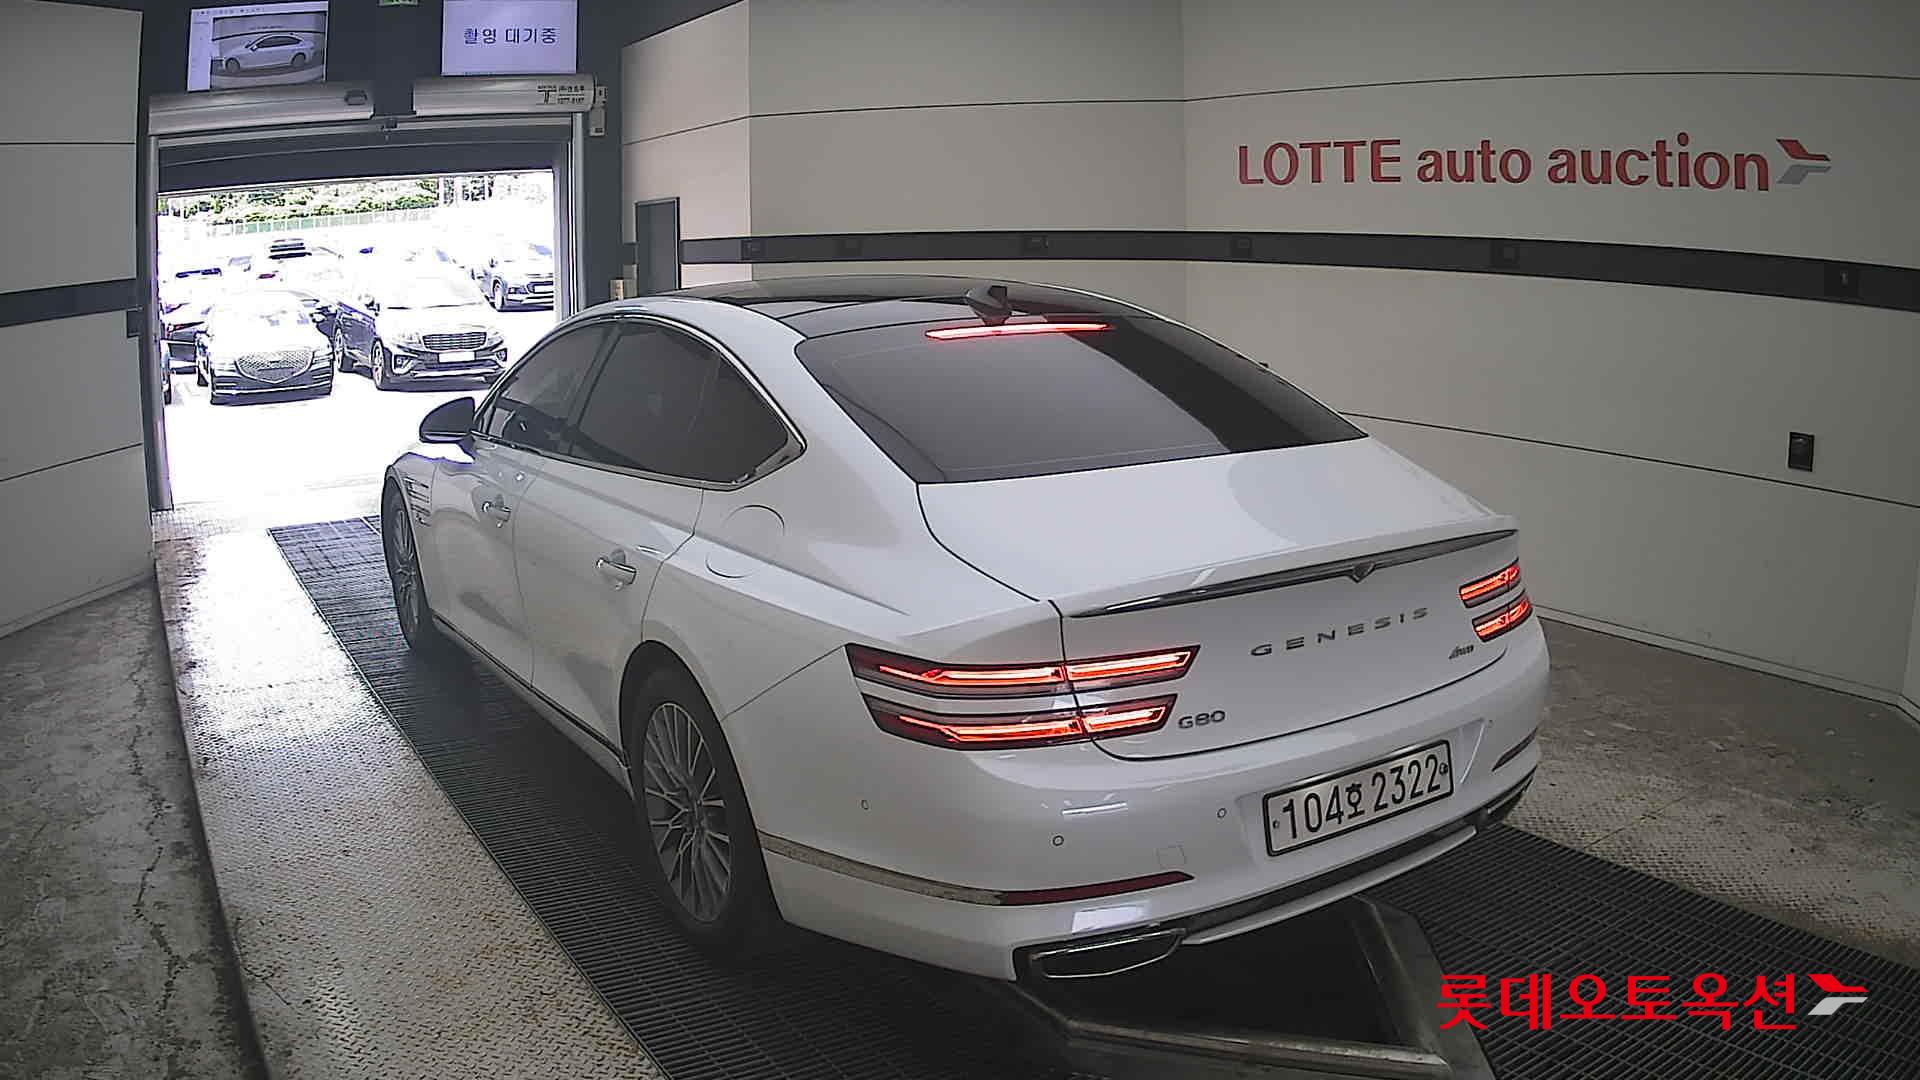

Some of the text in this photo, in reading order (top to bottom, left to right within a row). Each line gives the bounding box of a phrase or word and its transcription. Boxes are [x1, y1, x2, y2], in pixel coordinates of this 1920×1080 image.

[505, 28, 557, 44] 대기중
[1239, 132, 1769, 191] LOTTE auto auction
[1250, 607, 1428, 657] GENESIS
[1178, 710, 1226, 729] G80
